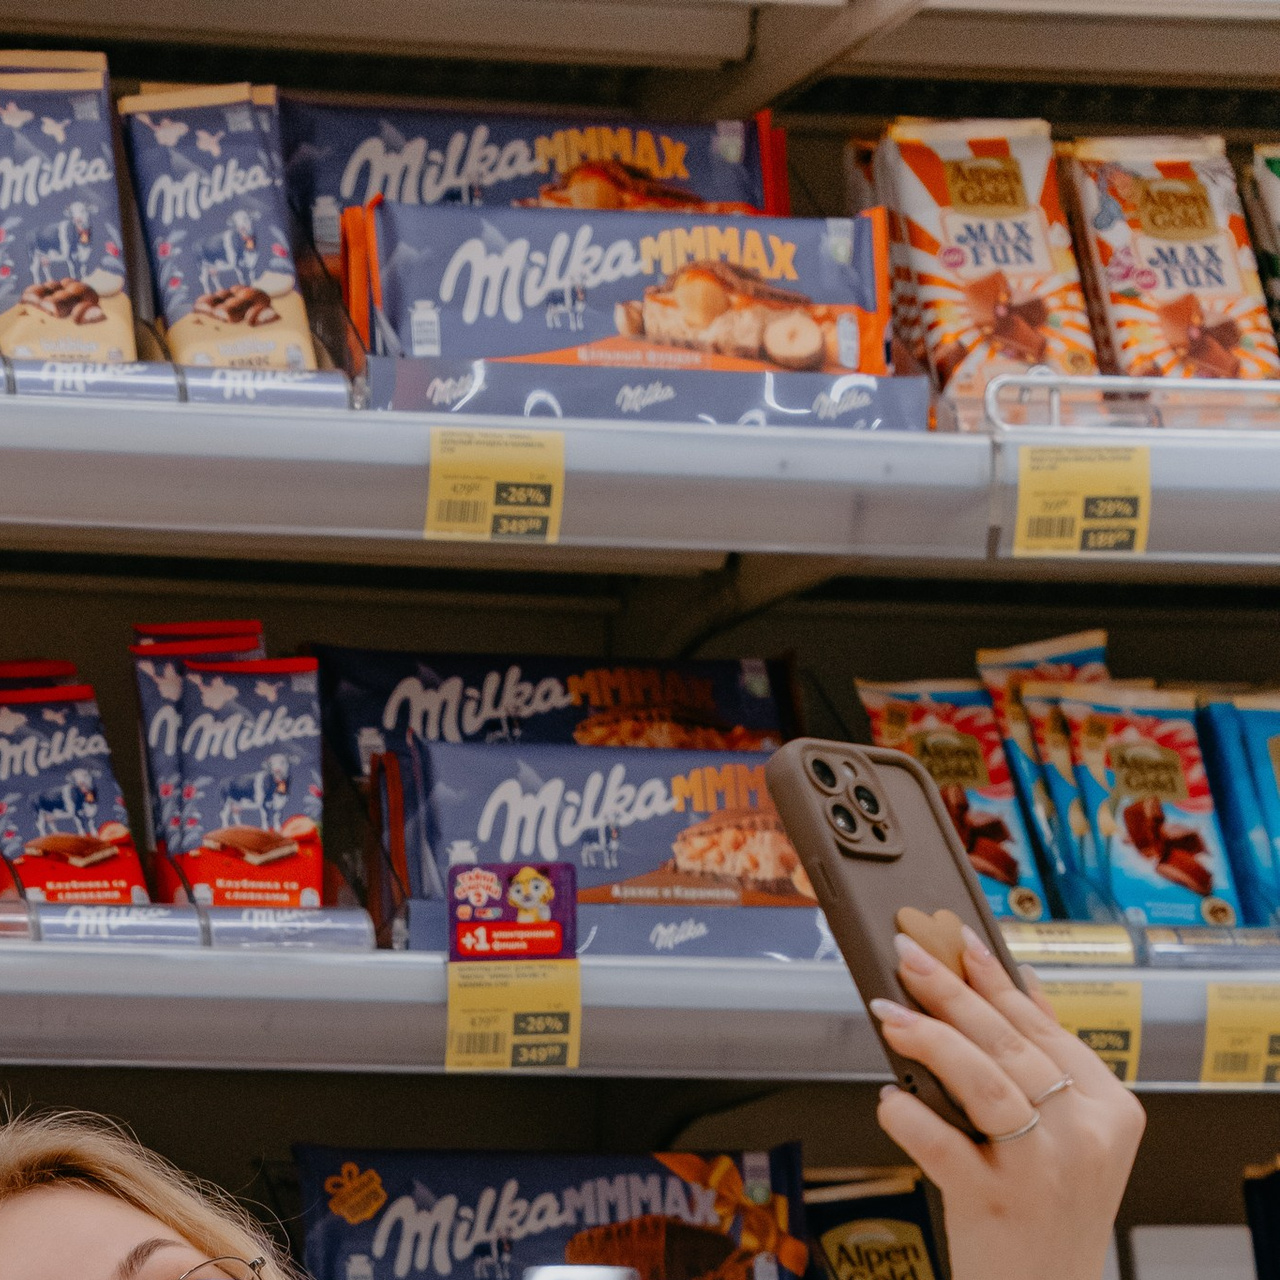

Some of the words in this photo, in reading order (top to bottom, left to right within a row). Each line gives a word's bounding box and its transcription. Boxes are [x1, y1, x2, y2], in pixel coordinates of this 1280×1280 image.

[341, 126, 542, 203] Milka
[535, 124, 690, 181] MMMAX
[146, 158, 272, 226] Milka
[956, 220, 1033, 249] MAX
[970, 241, 1035, 270] FUN
[1148, 239, 1224, 270] MAX
[439, 225, 645, 324] Milka
[639, 226, 799, 281] MMMAX
[1161, 262, 1227, 290] FUN
[383, 665, 575, 742] Milka
[181, 705, 320, 762] Milka
[477, 764, 682, 862] Milka
[671, 764, 767, 813] MMM
[461, 927, 490, 951] +1
[649, 918, 709, 950] Milka
[372, 1178, 567, 1280] Milka
[561, 1172, 719, 1226] MMMAX
[836, 1241, 920, 1272] Alpen
